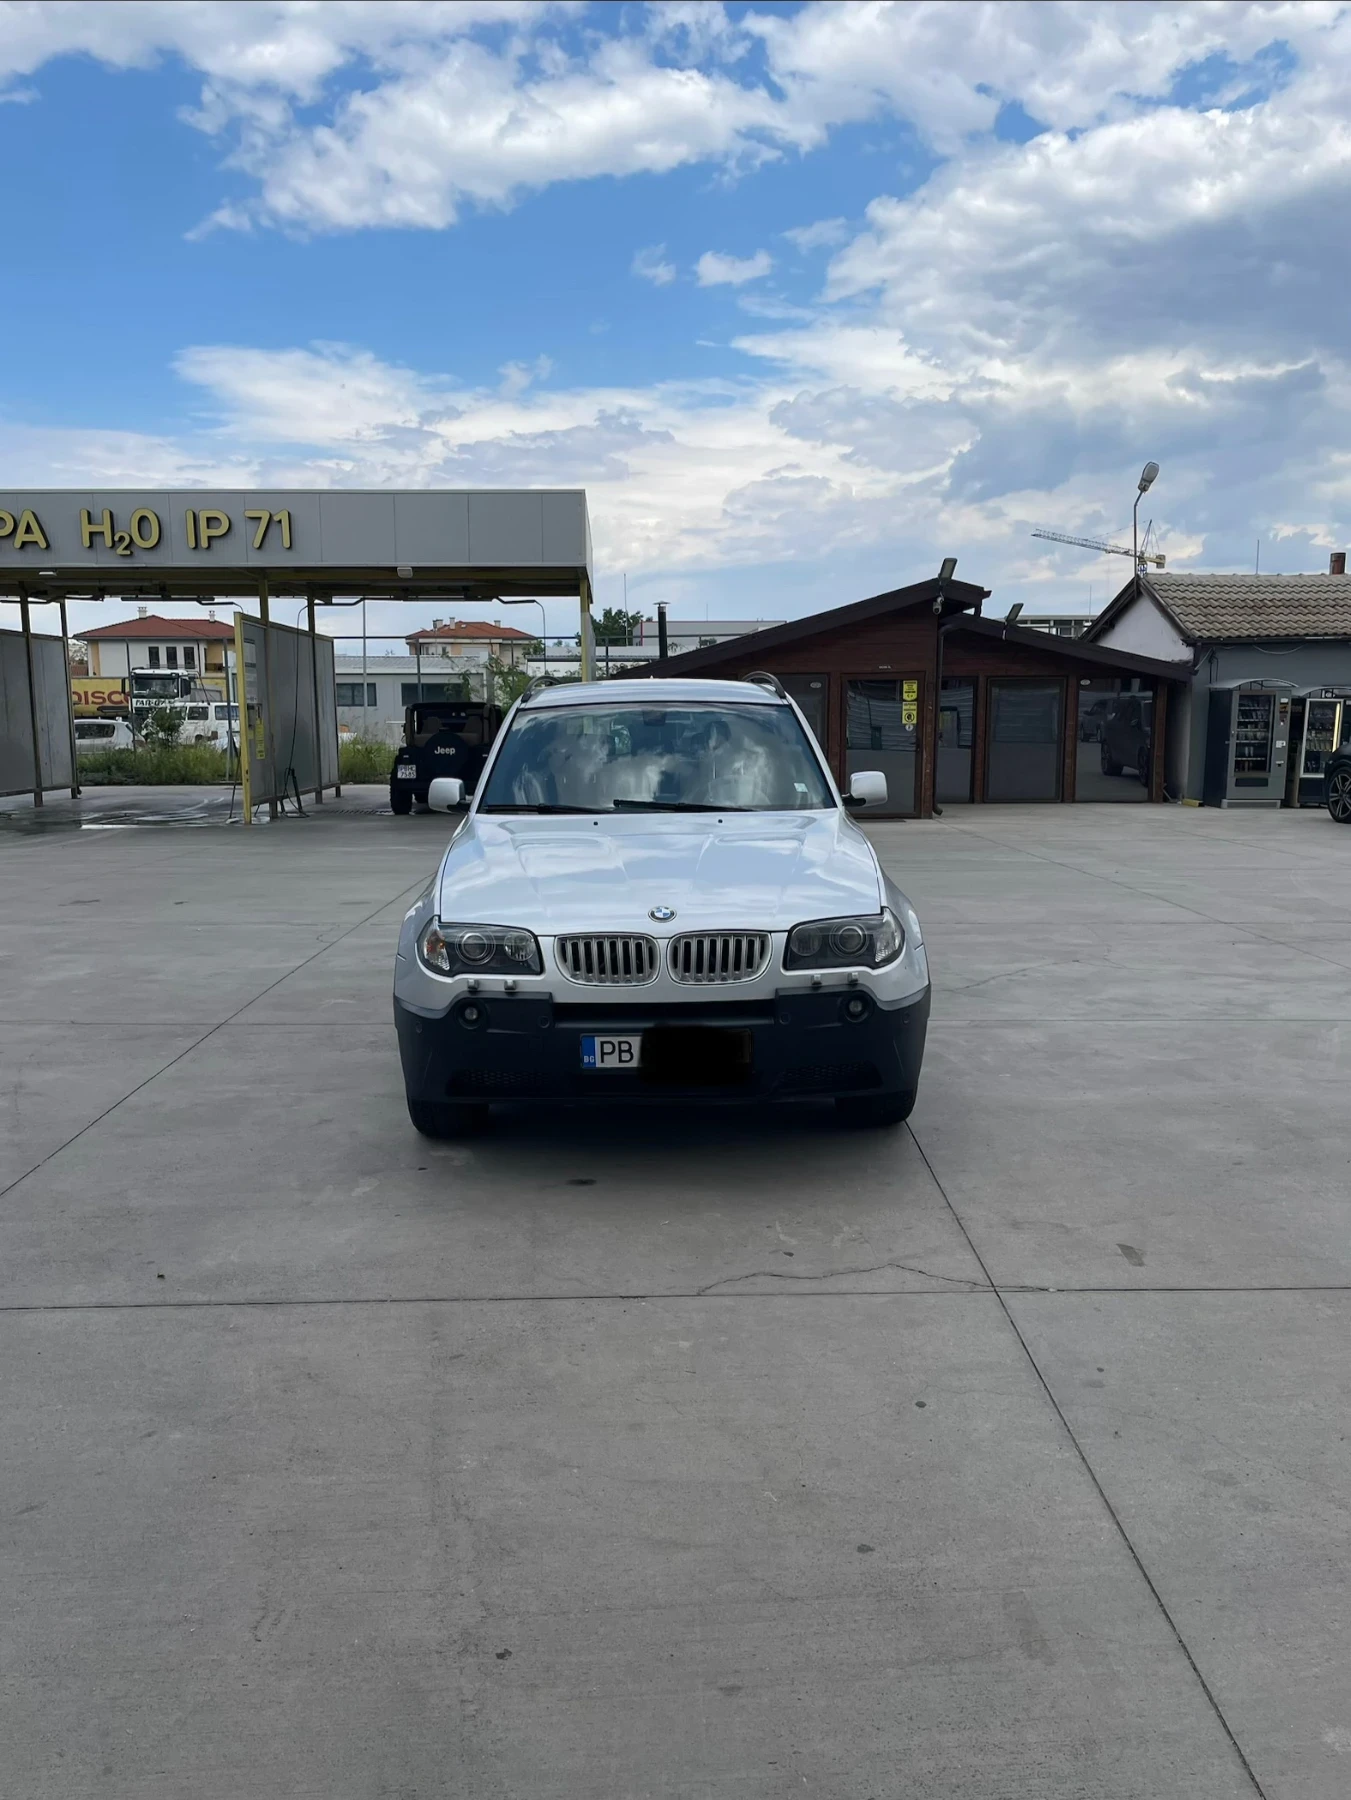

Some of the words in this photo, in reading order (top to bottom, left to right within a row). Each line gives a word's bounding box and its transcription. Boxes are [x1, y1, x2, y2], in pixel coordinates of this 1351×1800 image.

[186, 509, 230, 548] IP
[244, 509, 291, 548] 71
[434, 745, 456, 756] Jeep
[583, 1055, 595, 1063] BG
[599, 1040, 634, 1064] PB
